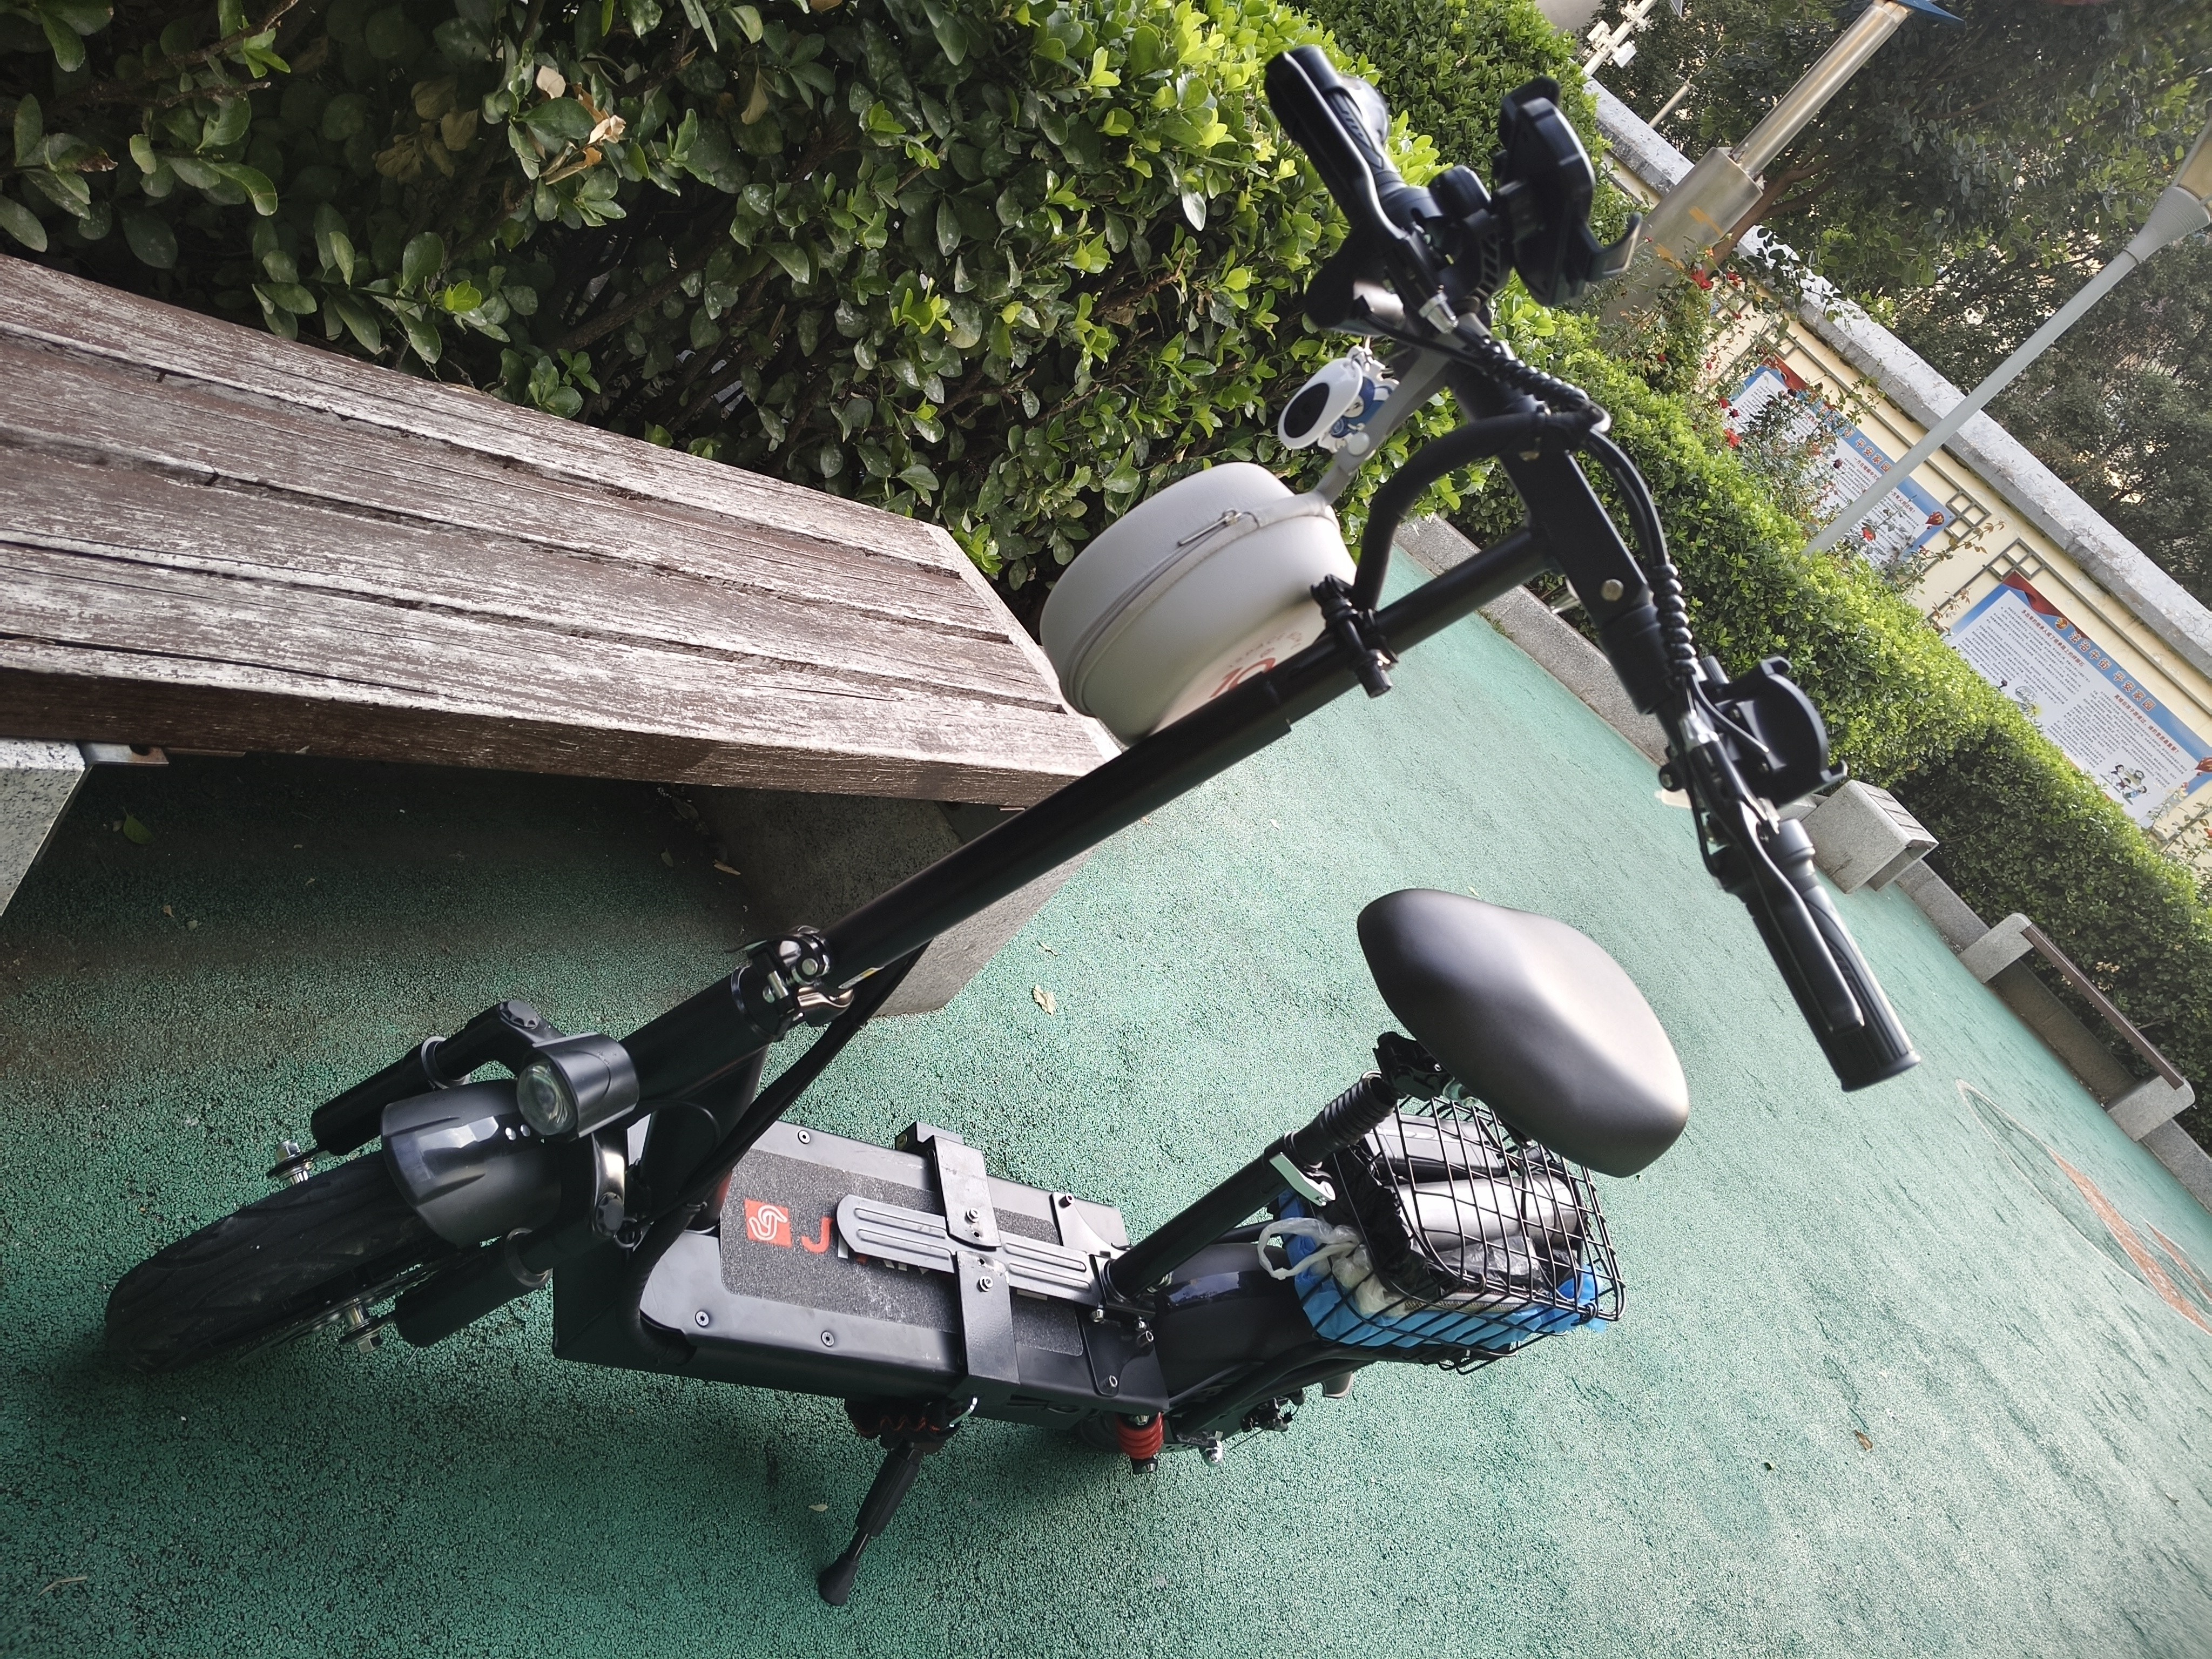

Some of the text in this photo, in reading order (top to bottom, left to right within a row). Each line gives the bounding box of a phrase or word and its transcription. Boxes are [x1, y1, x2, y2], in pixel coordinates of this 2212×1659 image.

[1853, 436, 1892, 473] 平安家园
[2067, 630, 2113, 671] 法治牛街
[2110, 670, 2157, 711] 平安家园
